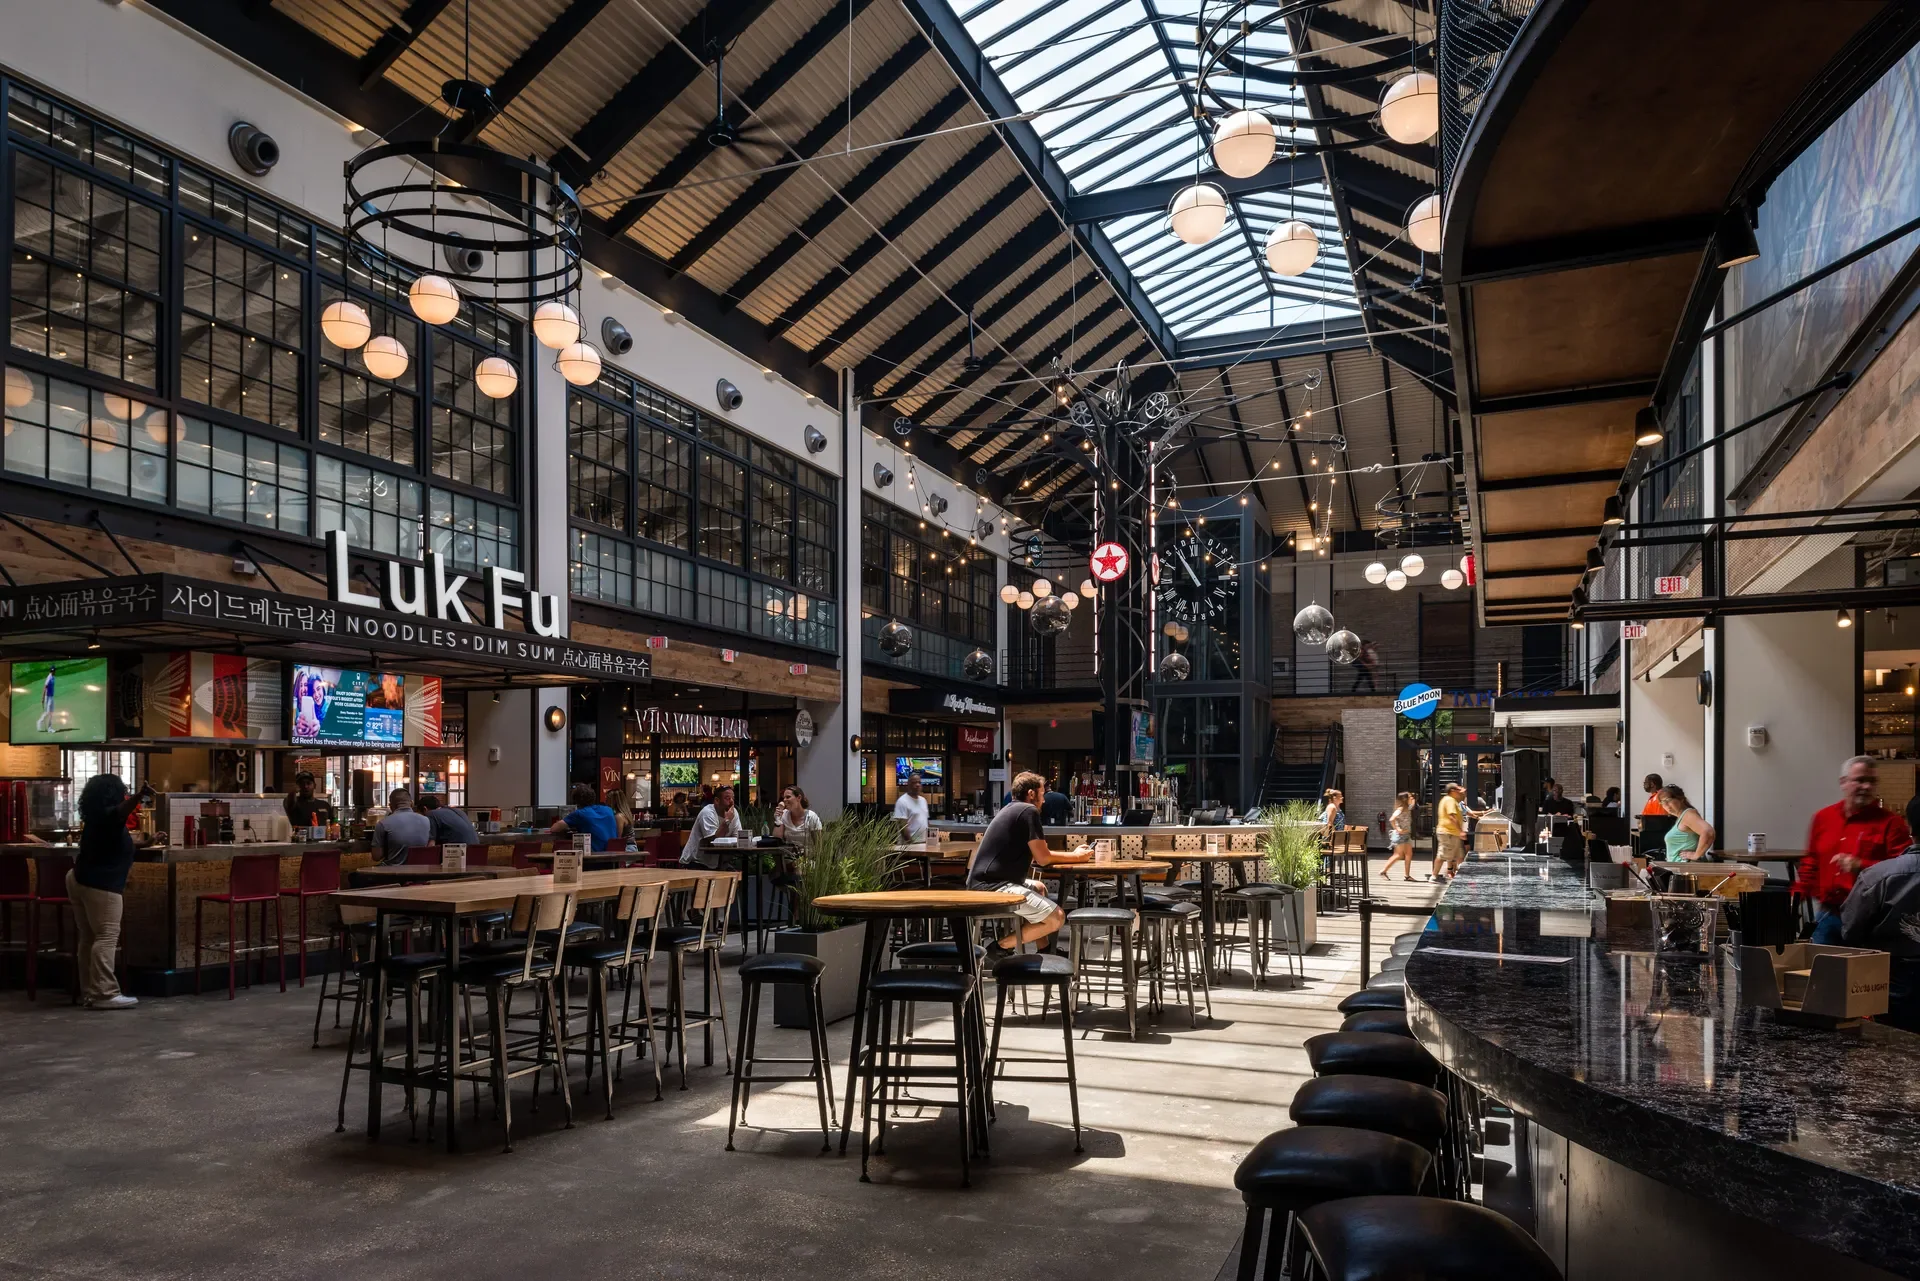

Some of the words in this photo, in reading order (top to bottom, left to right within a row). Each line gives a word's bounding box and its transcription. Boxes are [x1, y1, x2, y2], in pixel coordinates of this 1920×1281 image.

[326, 530, 472, 624] Luk
[483, 566, 560, 639] Fu
[1660, 577, 1681, 592] EXIT
[171, 585, 336, 634] 사이드메뉴딤섬
[346, 615, 457, 648] NOODLES
[472, 635, 508, 655] DIM
[518, 641, 555, 661] SUM
[1624, 625, 1641, 638] EXIT
[1394, 698, 1417, 712] BLUE
[1418, 690, 1440, 704] MOON
[673, 712, 719, 737] WINE
[720, 717, 751, 739] BAR
[314, 738, 323, 746] has
